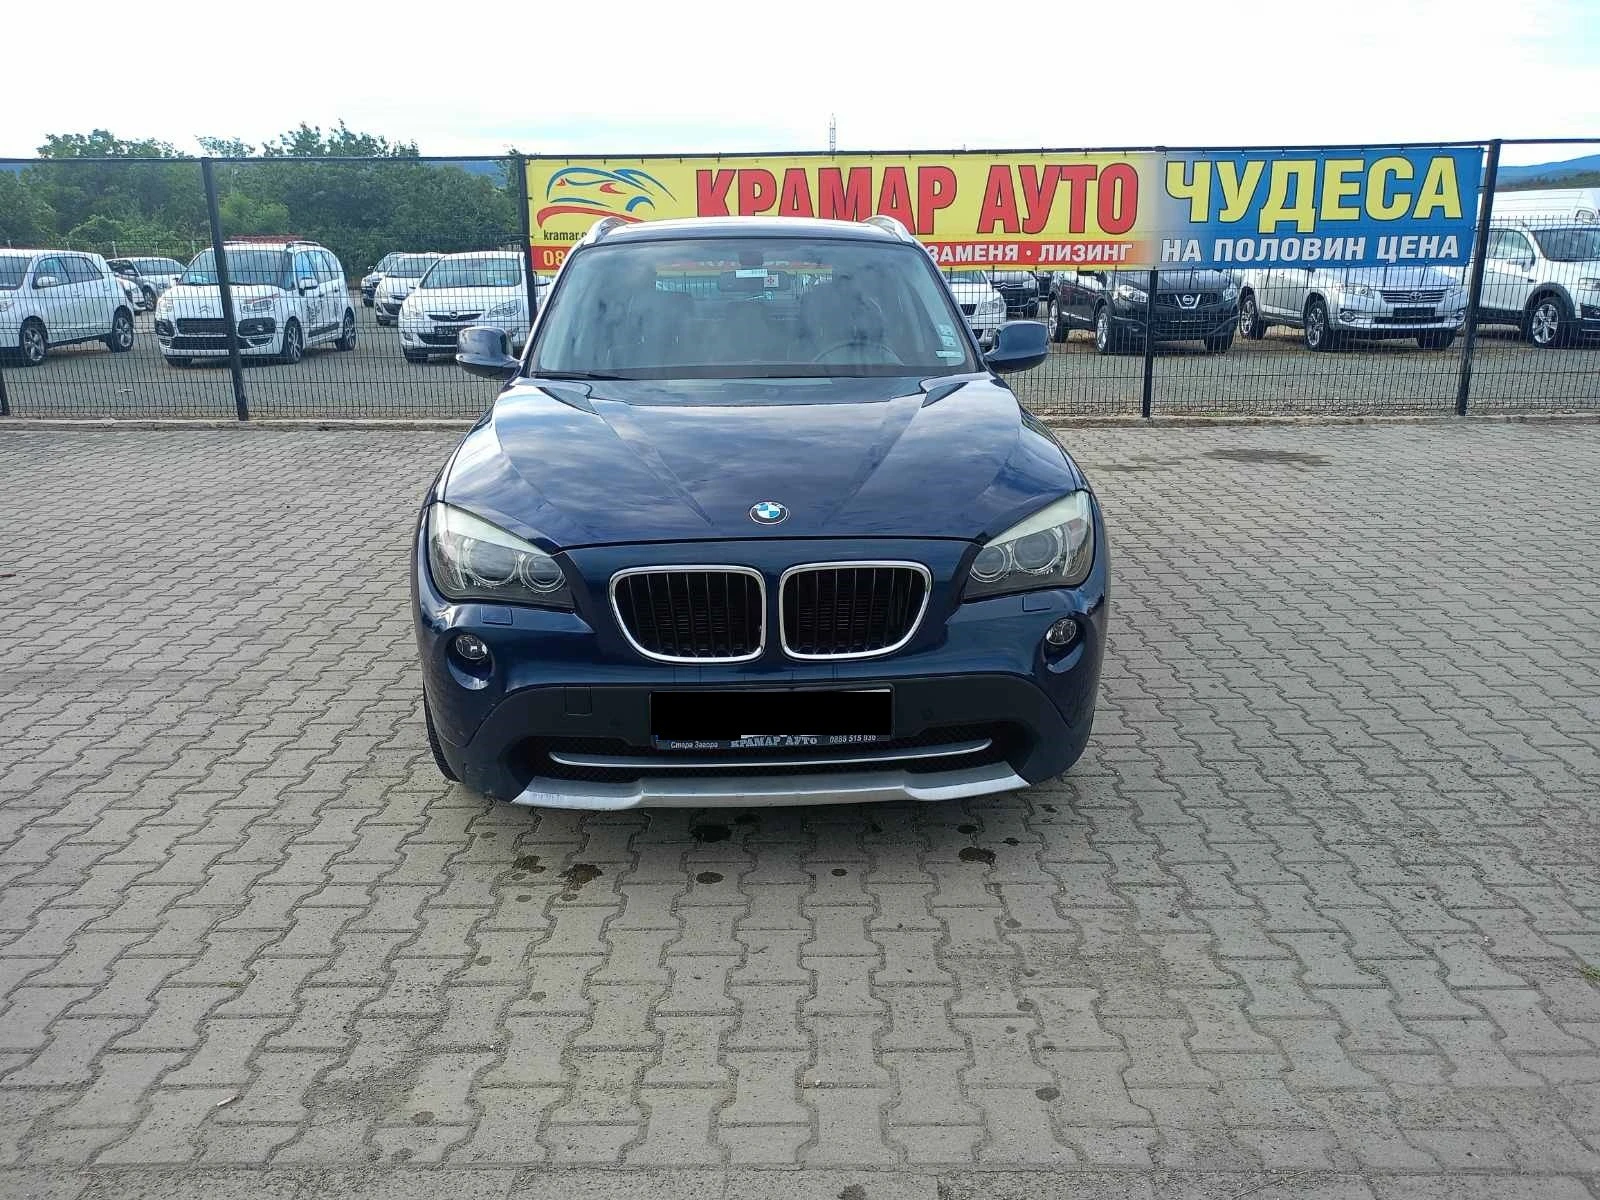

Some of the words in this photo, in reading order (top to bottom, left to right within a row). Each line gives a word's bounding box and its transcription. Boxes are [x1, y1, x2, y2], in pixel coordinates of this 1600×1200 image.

[694, 163, 958, 236] КРАМАР
[976, 162, 1139, 235] АУТО
[1165, 156, 1462, 234] ЧУДЕСА
[927, 243, 1019, 263] ЗАМЕНЯ
[1038, 243, 1134, 262] ЛИЗИНГ
[1160, 239, 1202, 262] НА
[1213, 236, 1367, 262] ПОЛОВИН
[1376, 235, 1459, 264] ЦЕНА
